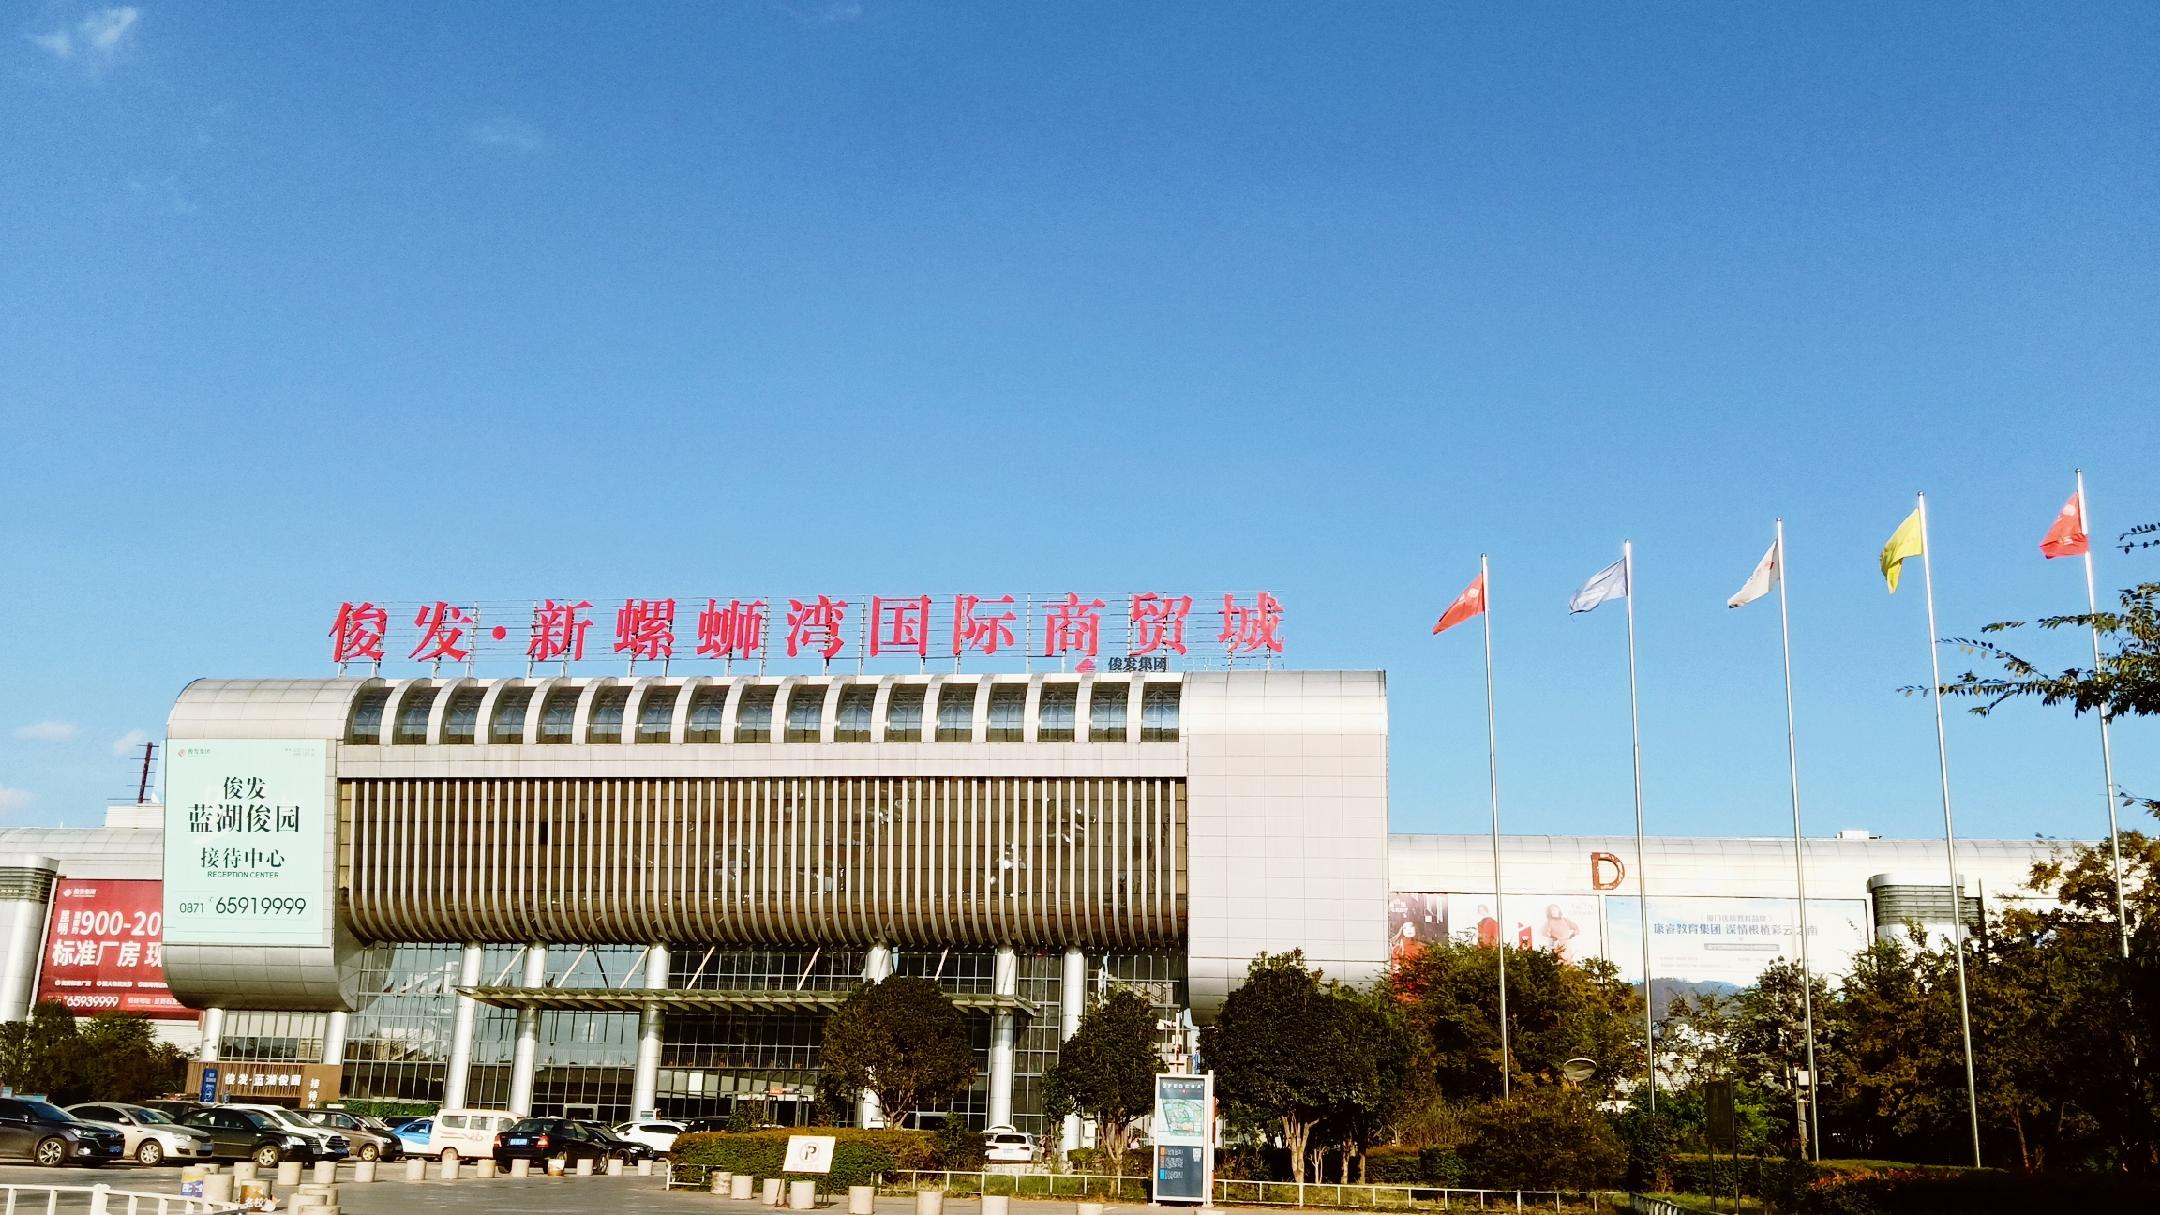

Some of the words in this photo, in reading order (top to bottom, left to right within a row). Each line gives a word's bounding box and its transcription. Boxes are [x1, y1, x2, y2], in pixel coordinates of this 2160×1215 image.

[328, 591, 1285, 662] 俊发·新螺蛳湾国际商贸城
[1107, 656, 1167, 672] 俊发集团
[223, 776, 266, 800] 俊发
[187, 803, 300, 833] 蓝湖俊园
[200, 847, 285, 869] 接待中心
[207, 870, 249, 878] RECEPTION
[1590, 851, 1626, 891] D
[179, 902, 204, 913] 0871
[215, 896, 307, 915] 65919999
[51, 939, 142, 968] 标准厂房
[66, 995, 120, 1008] 65939999
